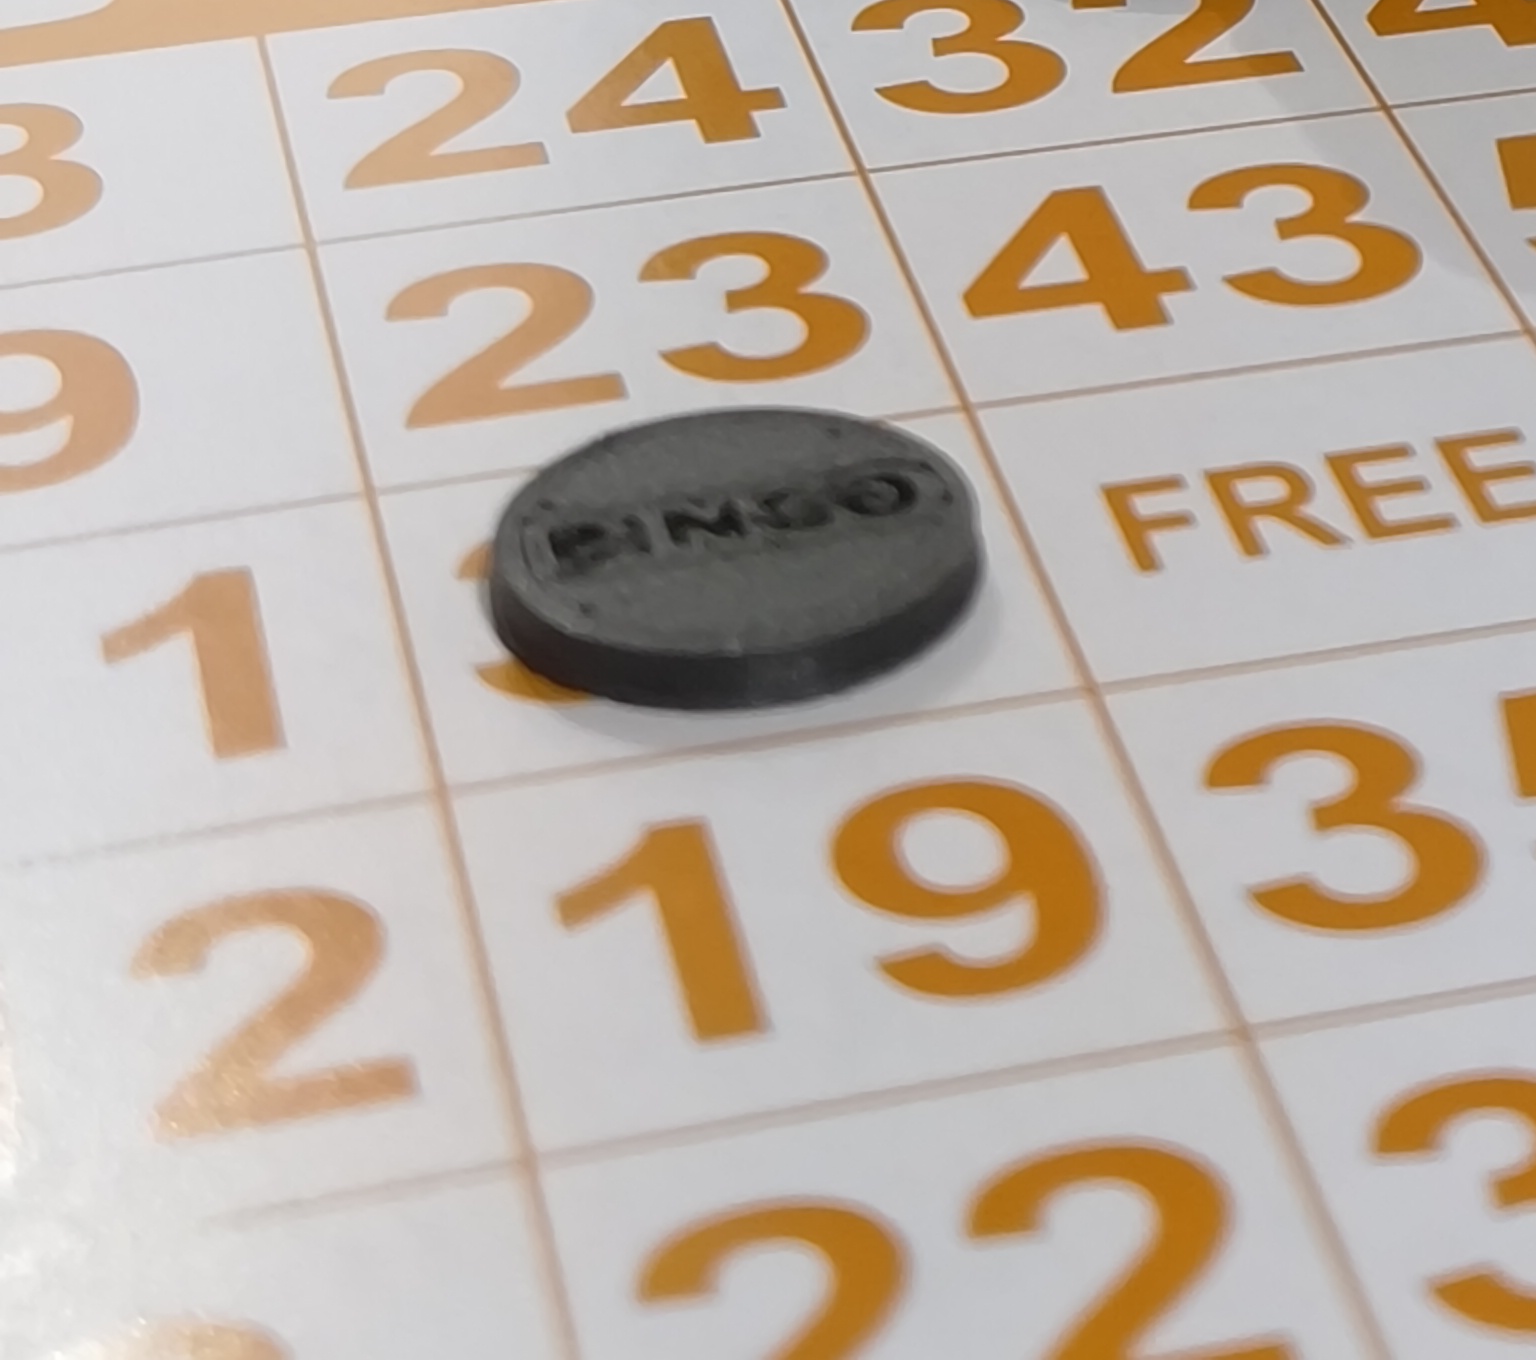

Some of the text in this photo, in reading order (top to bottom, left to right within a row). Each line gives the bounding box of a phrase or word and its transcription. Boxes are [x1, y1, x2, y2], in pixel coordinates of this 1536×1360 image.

[326, 15, 787, 191] 24
[384, 230, 872, 430] 23
[961, 162, 1423, 332] 43
[98, 565, 288, 762] 1
[129, 884, 421, 1144] 2
[551, 773, 1108, 1045] 19
[632, 1132, 1296, 1360] 22
